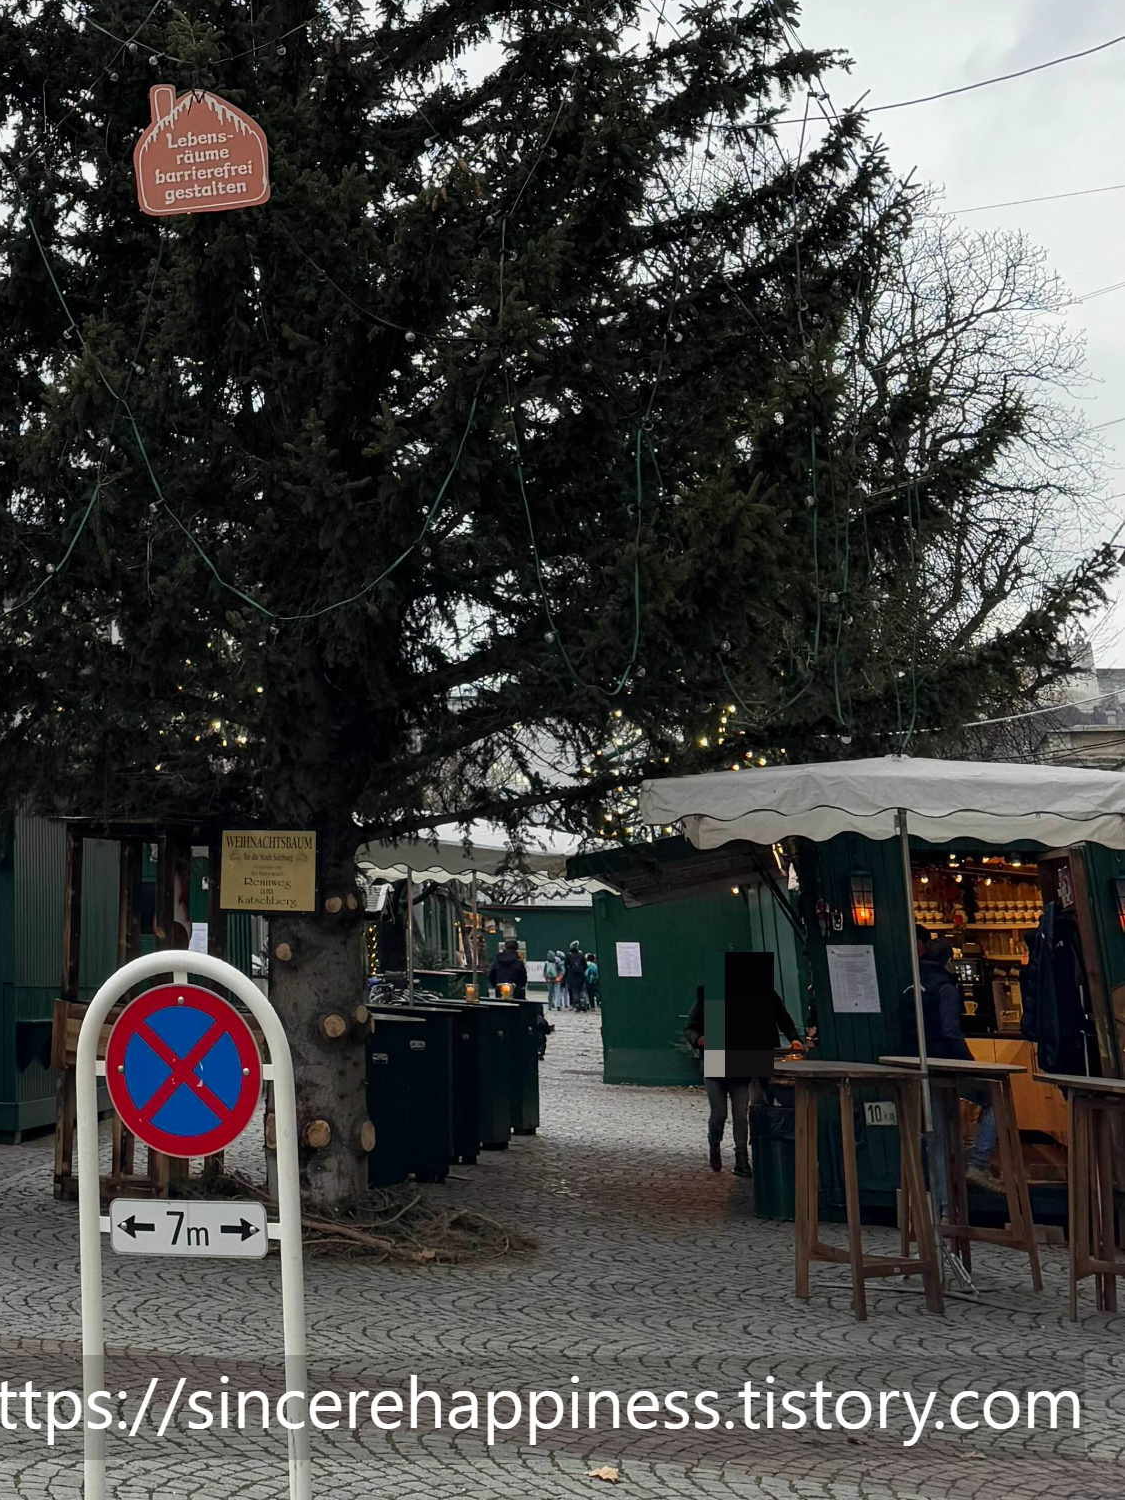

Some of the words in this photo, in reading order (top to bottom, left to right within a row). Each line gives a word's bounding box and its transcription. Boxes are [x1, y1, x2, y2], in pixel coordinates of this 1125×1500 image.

[166, 131, 234, 149] Lebens-
[176, 148, 230, 165] räume
[154, 160, 253, 185] barrierefrei
[164, 180, 247, 205] gestalten
[226, 835, 313, 850] WEIHNACHTSBAUM
[244, 877, 292, 890] Rennweg
[237, 895, 297, 908] Katschberg
